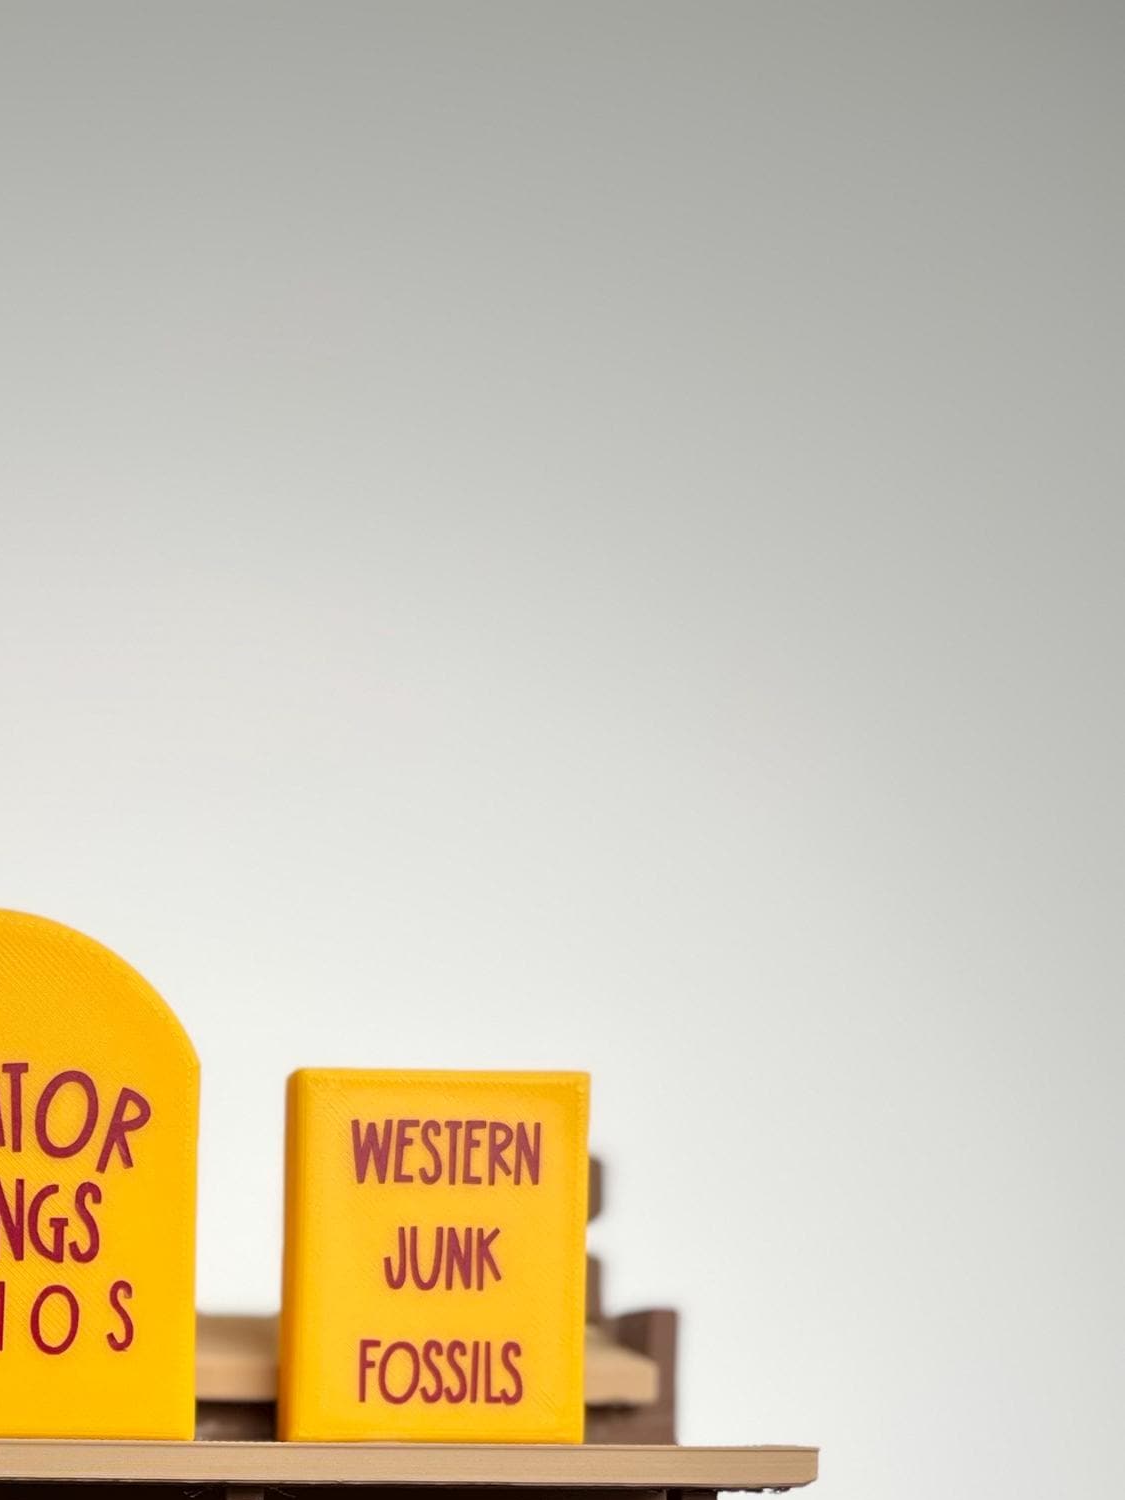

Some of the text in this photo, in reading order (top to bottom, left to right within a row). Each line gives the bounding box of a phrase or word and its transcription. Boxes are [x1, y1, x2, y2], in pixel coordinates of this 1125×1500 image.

[351, 1119, 541, 1186] WESTERN
[383, 1226, 502, 1291] JUNK
[358, 1339, 524, 1406] FOSSILS
